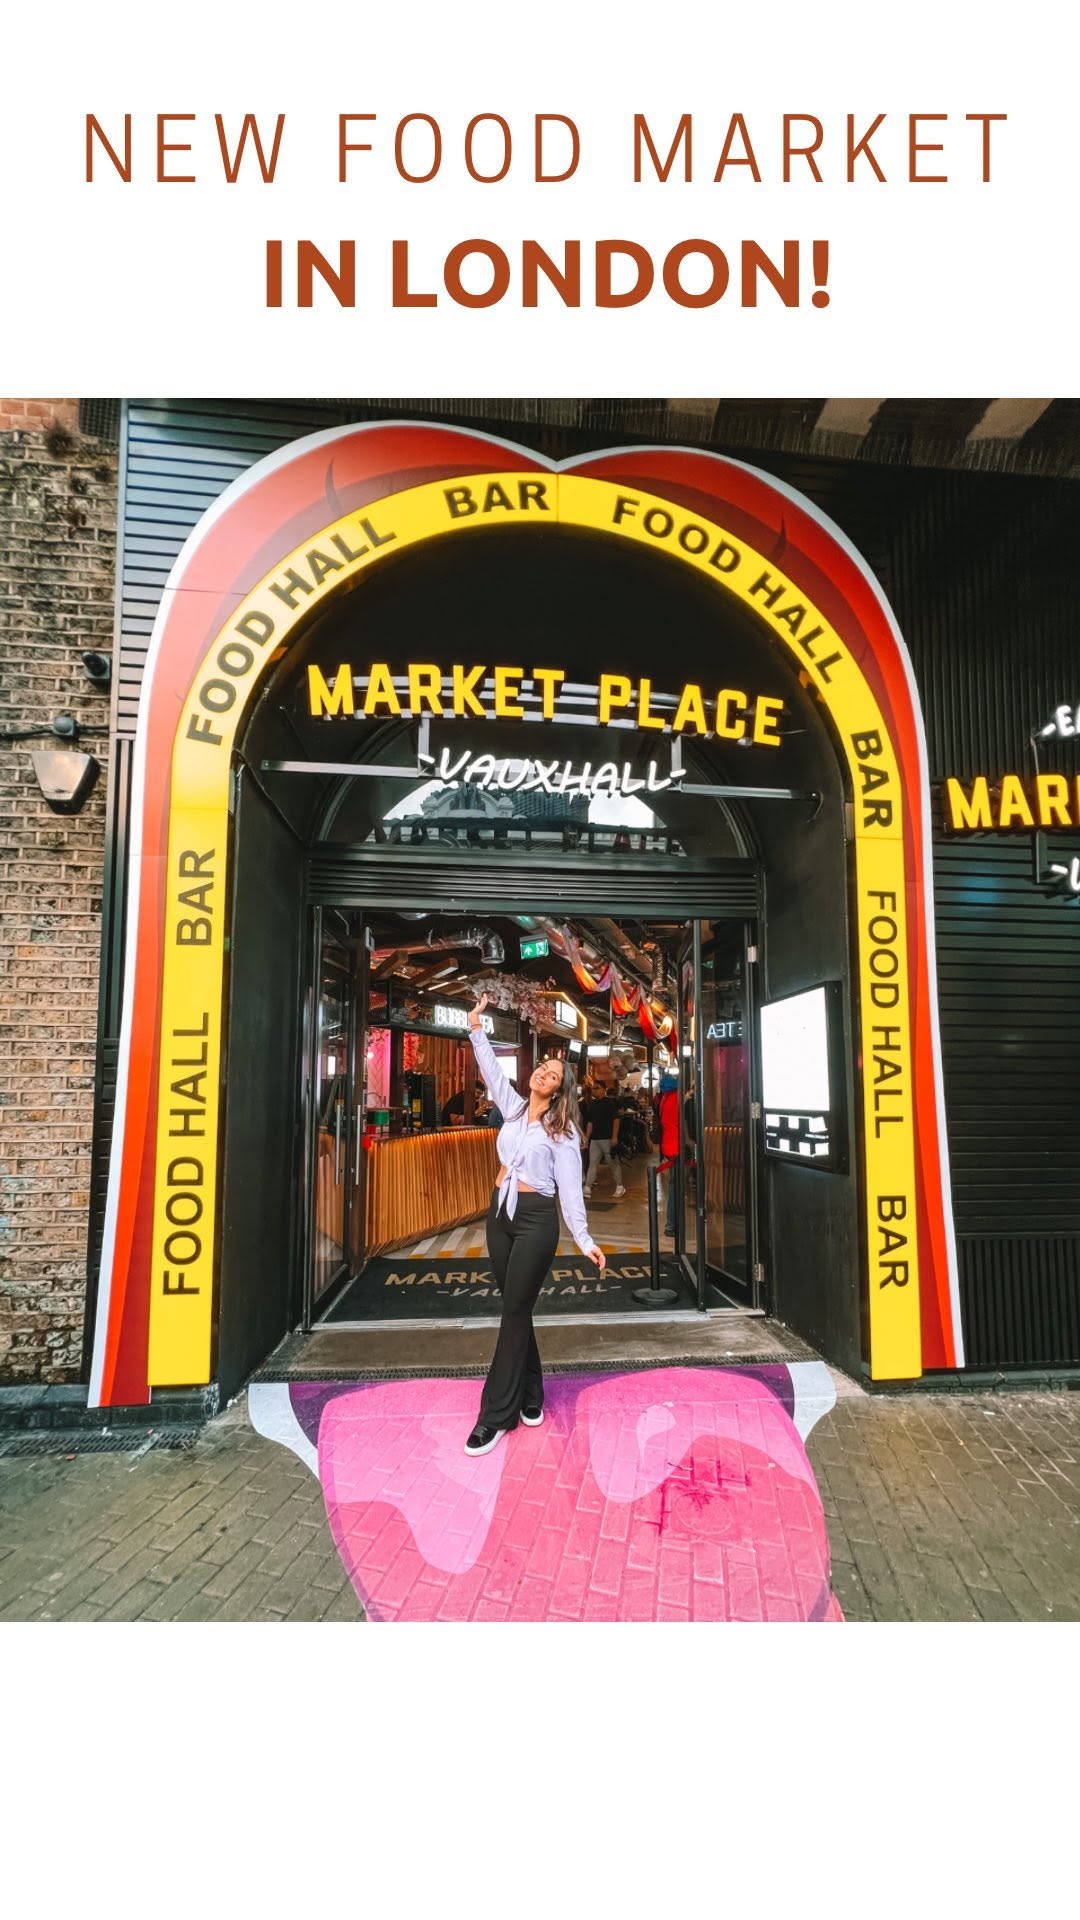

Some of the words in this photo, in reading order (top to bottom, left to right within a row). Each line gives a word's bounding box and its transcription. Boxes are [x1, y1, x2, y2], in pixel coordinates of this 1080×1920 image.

[442, 480, 551, 519] BAR
[186, 610, 275, 746] FOOD
[268, 517, 397, 610] HALL
[611, 494, 742, 574] FOOD
[748, 570, 843, 685] HALL
[307, 663, 566, 720] MARKET
[599, 673, 785, 747] PLACE
[850, 728, 894, 830] BAR
[947, 774, 1080, 829] MAR
[176, 848, 216, 946] BAR
[867, 890, 901, 1010] FOOD
[434, 1004, 470, 1030] BUBBL
[169, 1011, 209, 1137] HALL
[871, 1024, 906, 1138] HALL
[163, 1156, 204, 1296] FOOD
[877, 1195, 909, 1290] BAR
[384, 1271, 497, 1286] MARK
